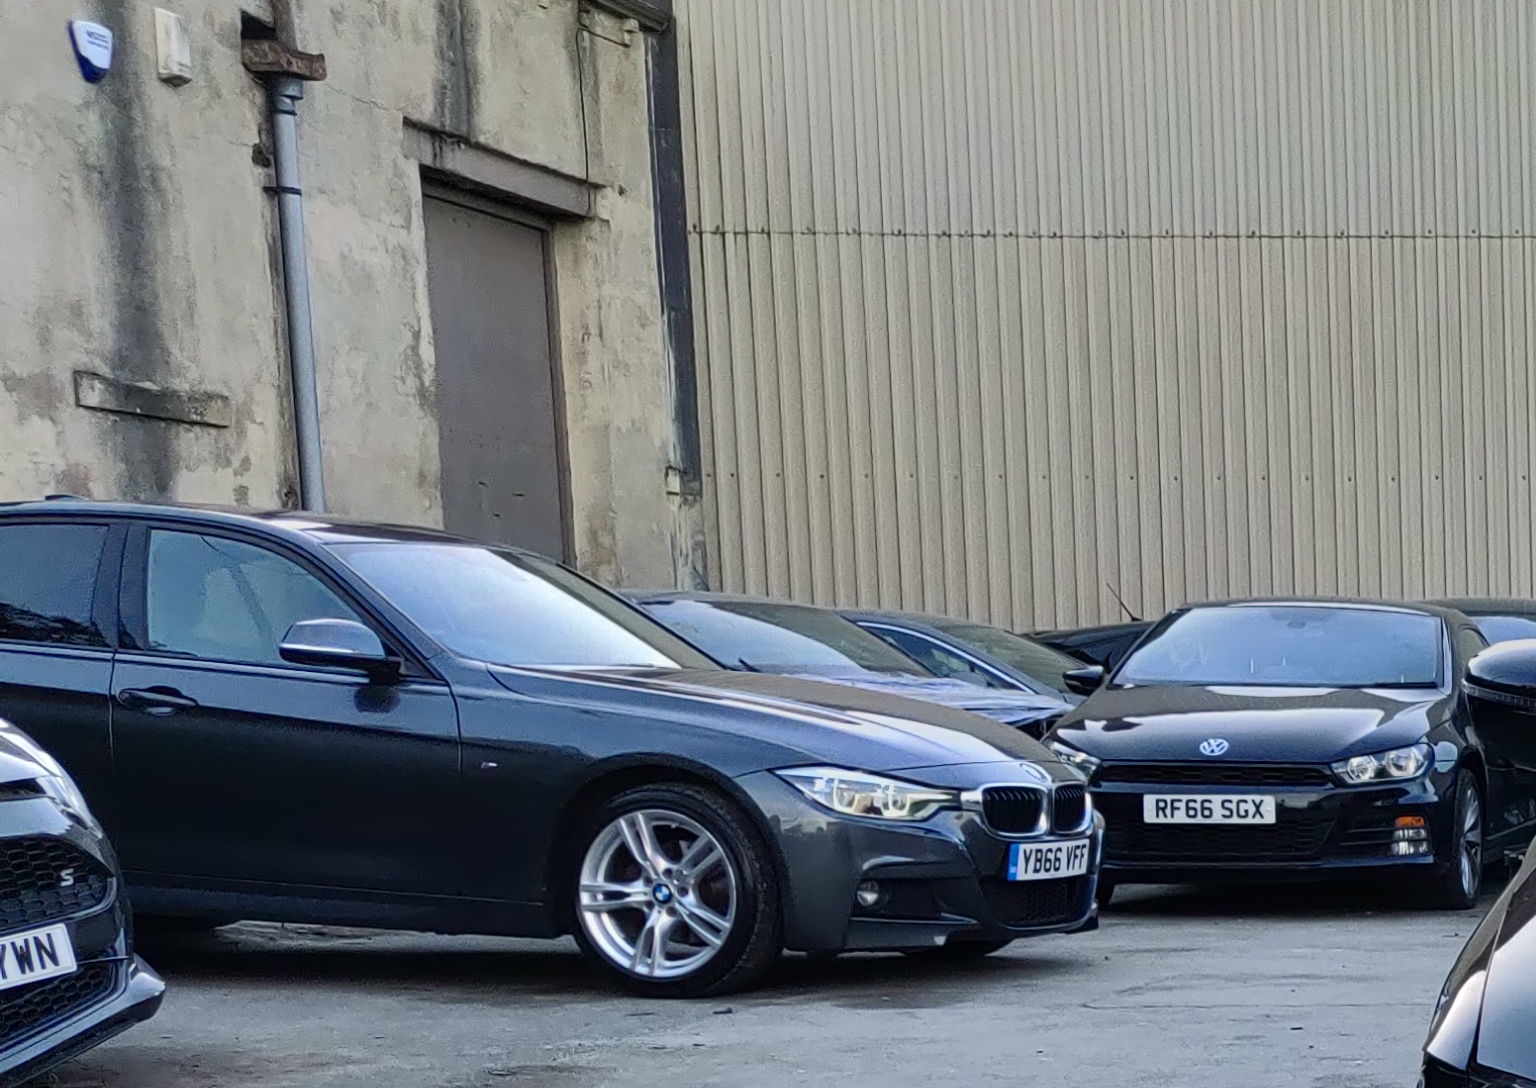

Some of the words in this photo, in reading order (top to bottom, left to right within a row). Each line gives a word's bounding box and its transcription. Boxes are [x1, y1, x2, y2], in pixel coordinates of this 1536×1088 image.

[1155, 798, 1213, 819] RF66
[1221, 799, 1264, 819] SGX
[1023, 847, 1062, 875] YB66
[1067, 844, 1087, 871] VFF
[60, 868, 75, 887] S
